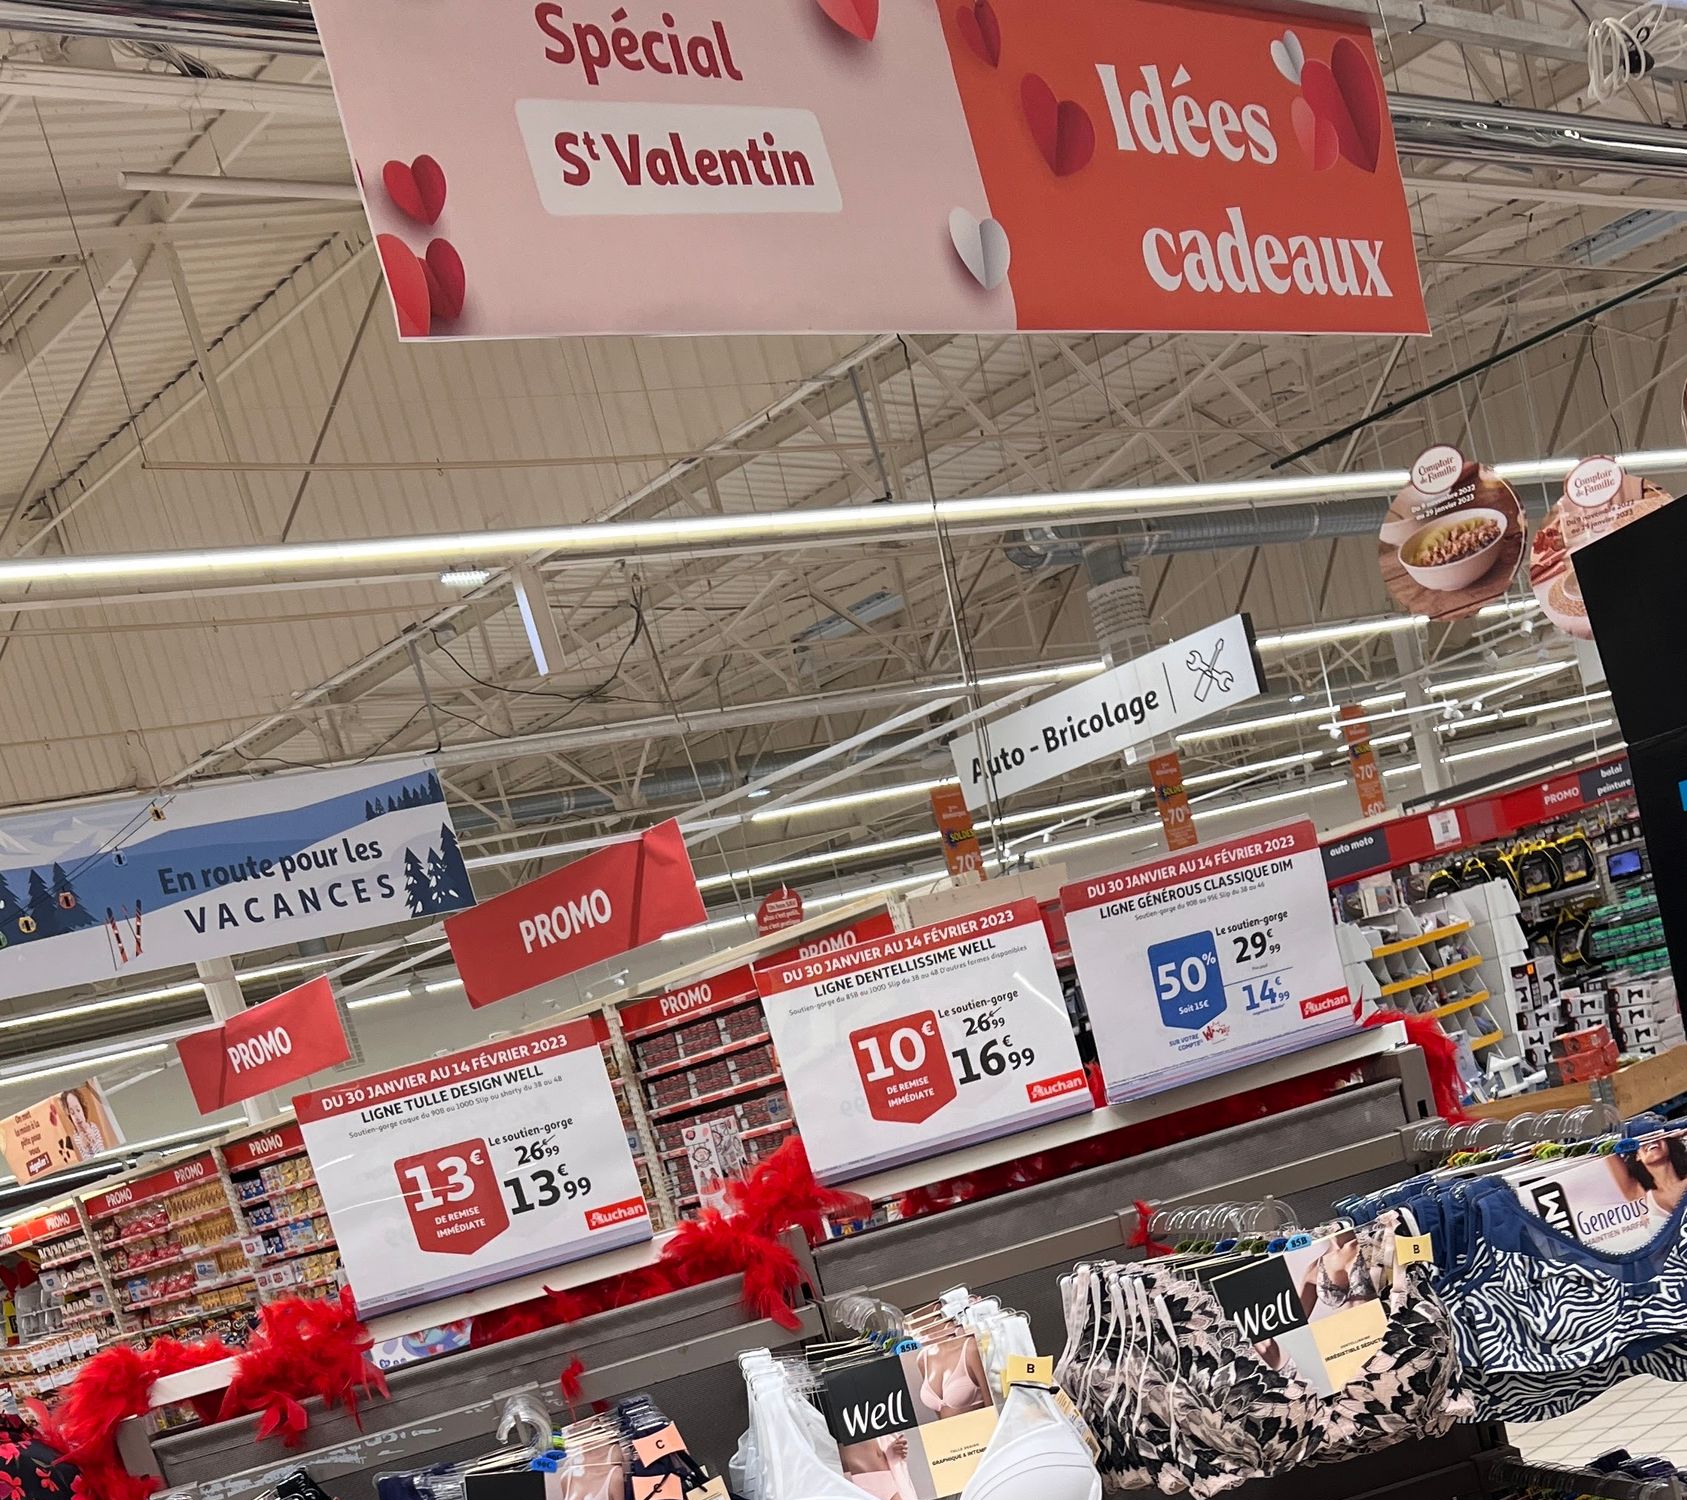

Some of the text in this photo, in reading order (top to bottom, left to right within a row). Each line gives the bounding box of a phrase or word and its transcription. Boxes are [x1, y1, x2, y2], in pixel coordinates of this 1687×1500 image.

[536, 2, 743, 85] Spécial
[1096, 63, 1278, 168] Idées
[603, 129, 815, 188] Valentin
[1143, 207, 1393, 298] cadeaux
[1575, 469, 1612, 488] Comptoir
[1584, 478, 1615, 496] Famille
[971, 685, 1159, 784] Auto Bricolage
[1600, 763, 1622, 778] balai
[1544, 786, 1580, 805] PROMO
[1597, 778, 1631, 796] peinture
[1330, 836, 1374, 857] auto moto
[157, 837, 383, 896] En route pour les
[1087, 834, 1295, 899] DU 30 JANVIER AU 14 FÉVRIER 2023
[1100, 859, 1293, 920] LIGNE GÉNÉROUS CLASSIQUE DIM
[184, 873, 395, 935] VACANCES
[519, 888, 612, 954] PROMO
[1215, 910, 1288, 936] Le soutien-gorge
[783, 910, 1014, 984] DU 30 JANVIER AU 14 FÉVRIER 2023
[799, 931, 857, 959] PROMO
[814, 938, 996, 997] LIGNE DENTELLISSIME WELL
[1158, 952, 1217, 1001] 50%
[660, 984, 712, 1016] PROMO
[789, 999, 835, 1016] Soutien-gorge
[938, 989, 1019, 1019] Le soutien-gorge
[1179, 1000, 1209, 1015] Soit 15€
[1304, 993, 1348, 1015] Auchan
[227, 1026, 292, 1074] PROMO
[858, 1020, 936, 1082] 10€
[321, 1034, 568, 1111] DU 30 JANVIER AU 14 FÉVRIER 2023
[886, 1076, 929, 1095] DE REMISE
[361, 1065, 544, 1123] LIGNE TULLE DESIGN WELL
[888, 1088, 935, 1108] IMMÉDIATE
[1031, 1076, 1082, 1099] Auchan
[349, 1120, 398, 1139] Soutien-gorge
[488, 1116, 573, 1147] Le soutien-gorge
[249, 1134, 283, 1157] PROMO
[174, 1161, 204, 1183] PROMO
[405, 1149, 484, 1212] 13€
[106, 1188, 132, 1207] PROMO
[45, 1213, 70, 1230] PROMO
[434, 1206, 480, 1225] DE REMISE
[590, 1203, 644, 1227] Auchan
[1577, 1198, 1649, 1235] Generous
[437, 1218, 486, 1239] IMMÉDIATE
[1291, 1238, 1307, 1248] 85B
[1413, 1245, 1420, 1254] B
[1233, 1289, 1299, 1341] Well
[901, 1343, 918, 1353] 85B
[1026, 1364, 1035, 1373] B
[842, 1389, 908, 1437] Well
[655, 1440, 665, 1449] C
